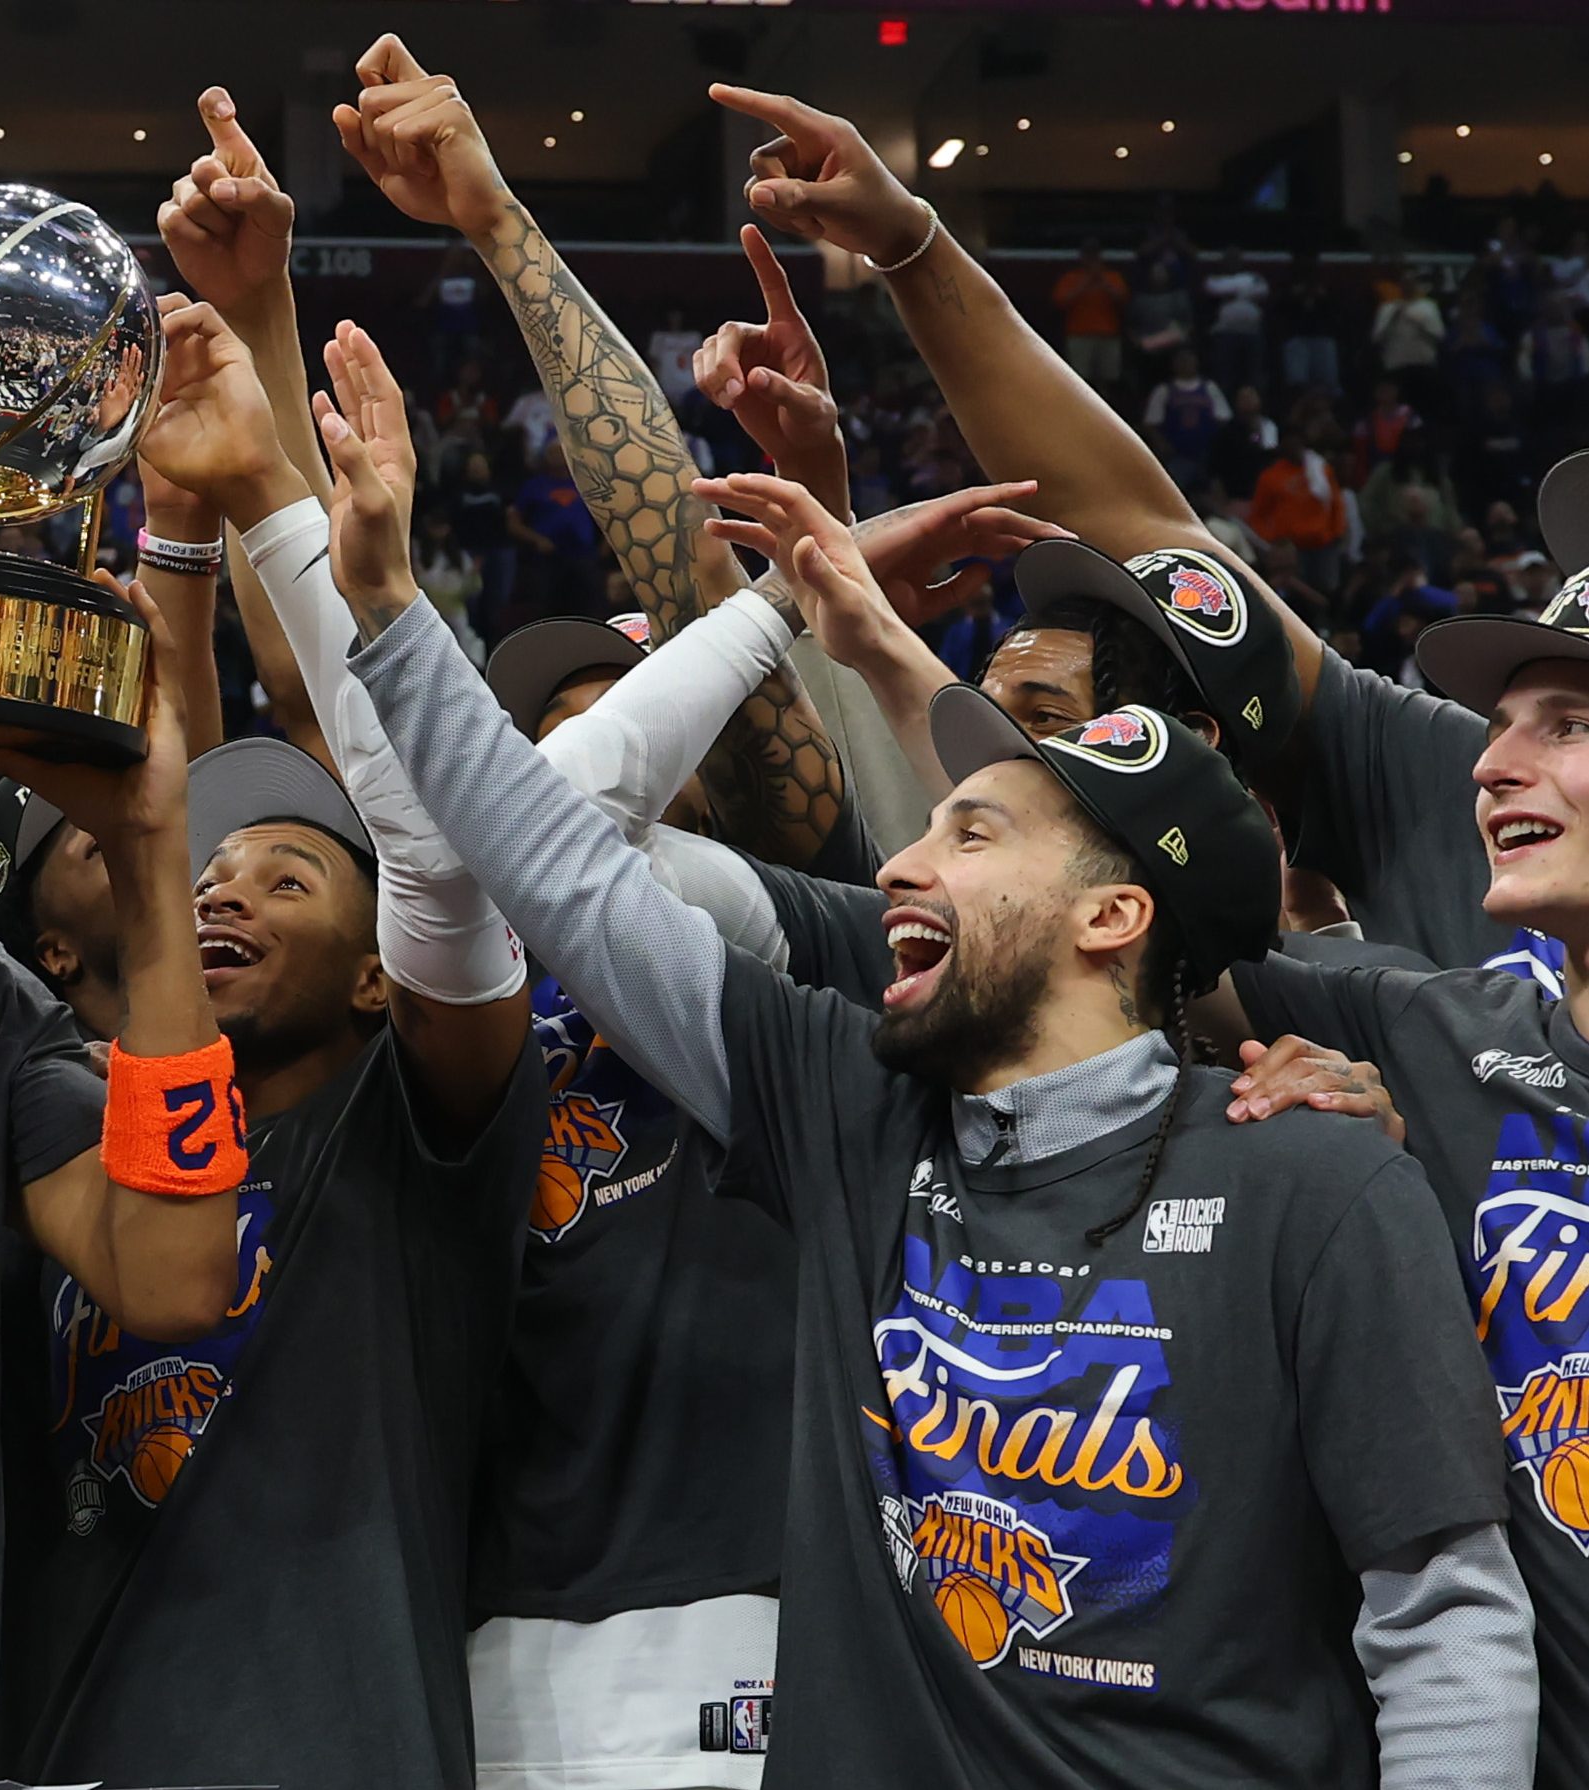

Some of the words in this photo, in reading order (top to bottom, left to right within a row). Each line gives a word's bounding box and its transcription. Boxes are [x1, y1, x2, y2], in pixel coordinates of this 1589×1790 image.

[157, 542, 187, 555] FOUR
[1491, 1158, 1560, 1171] EASTERN
[593, 1183, 624, 1208] NEW
[624, 1169, 656, 1196] YORK
[1177, 1196, 1226, 1225] LOCKER
[1173, 1225, 1214, 1253] ROOM
[945, 1305, 1053, 1335] CONFERENCE
[1054, 1320, 1173, 1340] CHAMPIONS
[128, 1367, 153, 1391] NEW
[153, 1360, 184, 1379] YORK
[95, 1366, 218, 1463] KNICKS
[867, 1316, 1183, 1498] Finals
[944, 1495, 973, 1513] NEW
[975, 1499, 1013, 1528] YORK
[912, 1503, 1064, 1616] KNICKS
[1018, 1646, 1052, 1673] NEW
[1053, 1652, 1095, 1681] YORK
[1095, 1658, 1155, 1688] KNICKS
[733, 1680, 757, 1689] ONCE
[758, 1680, 765, 1689] A
